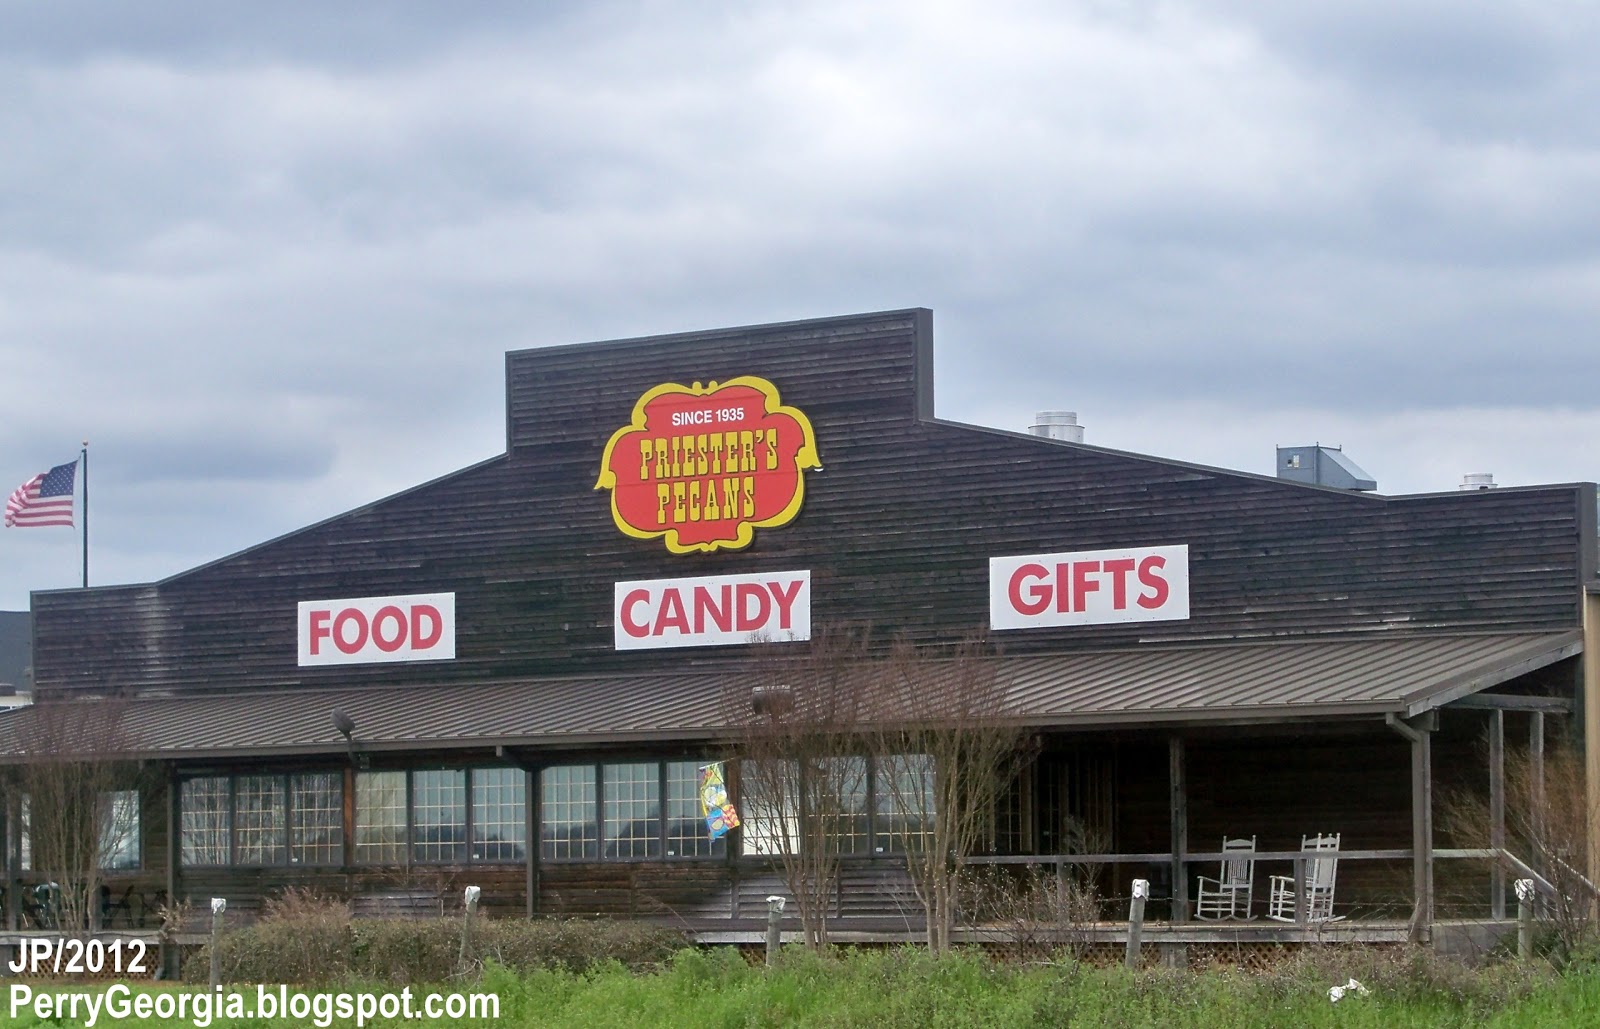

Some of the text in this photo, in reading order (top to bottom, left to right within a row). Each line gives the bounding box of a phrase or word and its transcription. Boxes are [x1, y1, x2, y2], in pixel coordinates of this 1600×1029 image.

[672, 408, 744, 426] SINCE 1935
[640, 428, 778, 480] PRIESTER'S
[657, 476, 755, 524] PECANS
[620, 580, 804, 638] CANDY
[1008, 555, 1169, 616] GIFTS
[309, 604, 443, 655] FOOD
